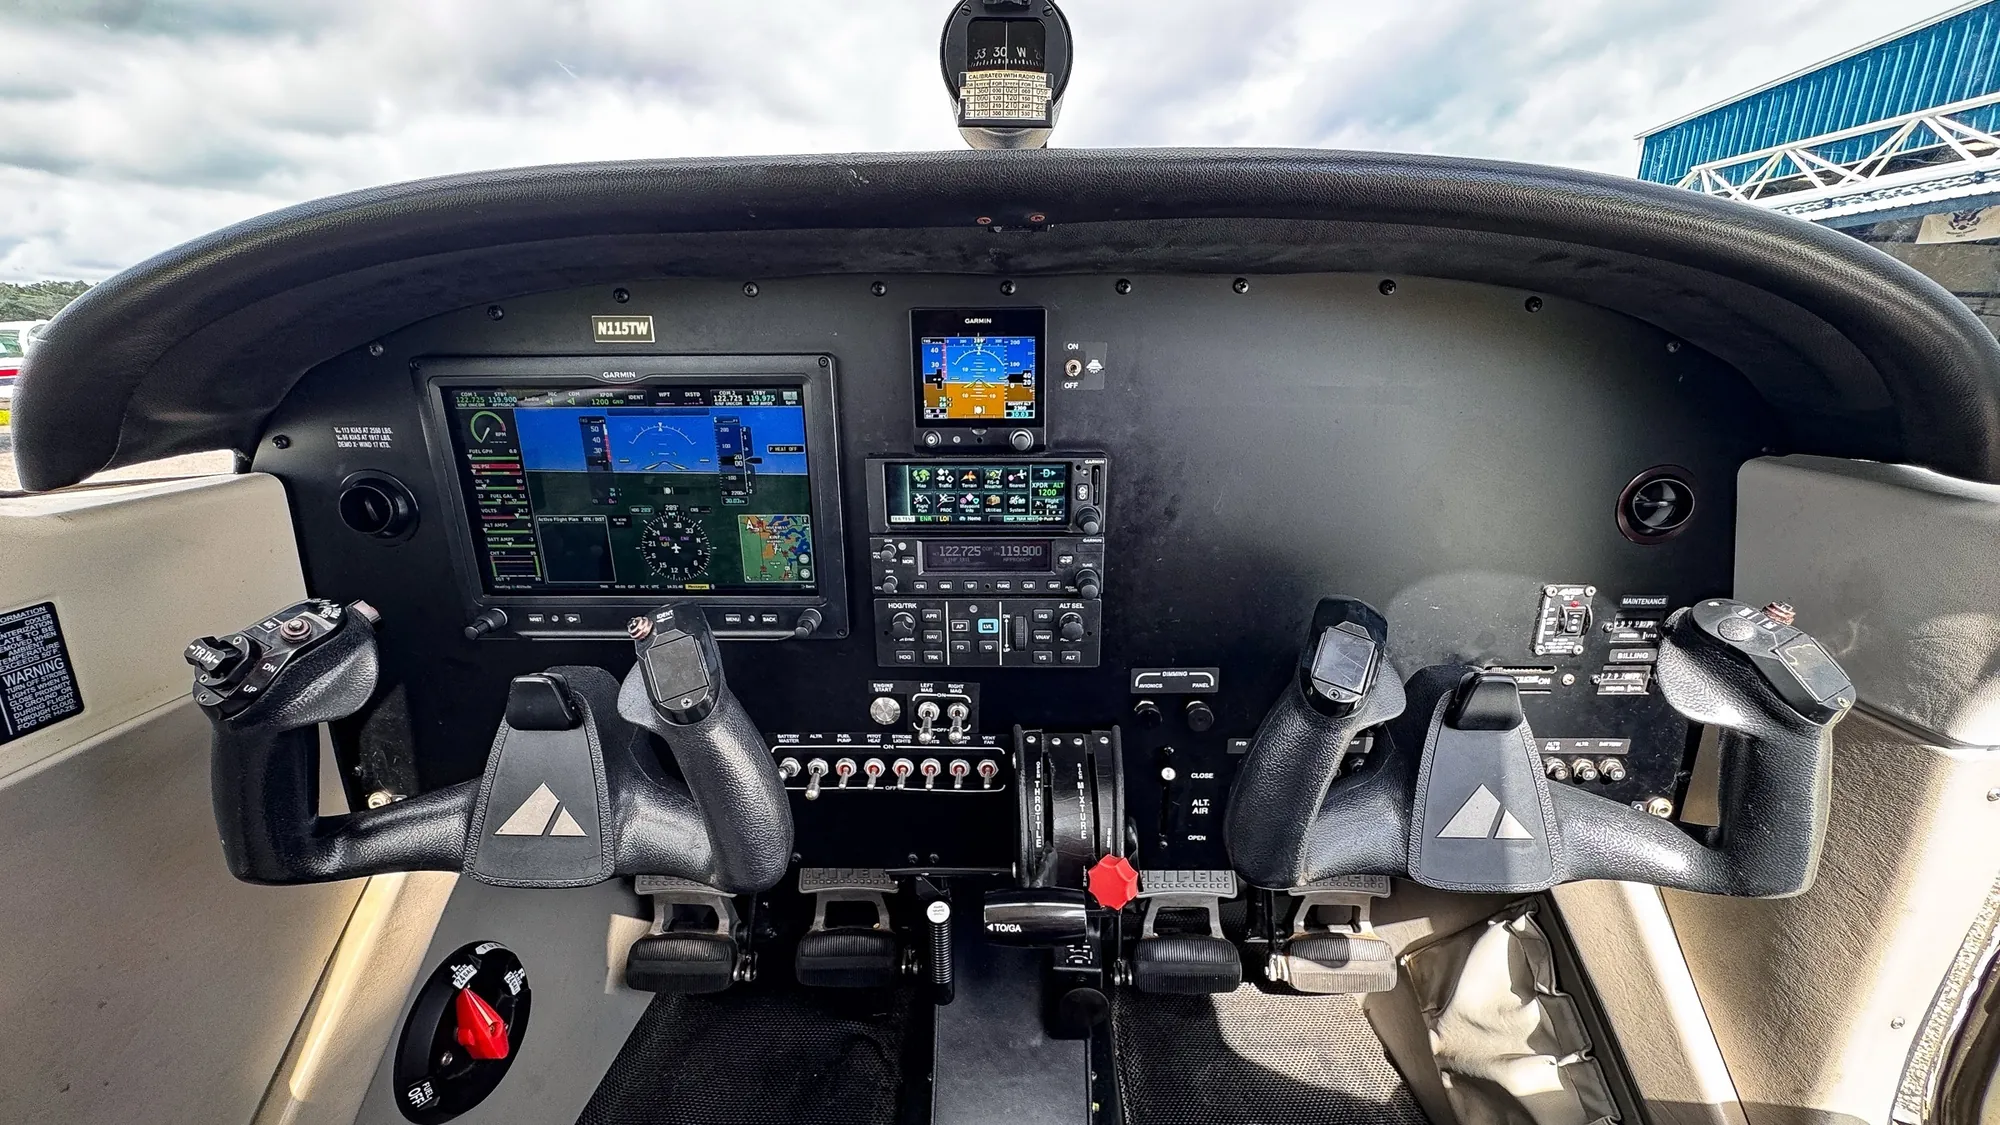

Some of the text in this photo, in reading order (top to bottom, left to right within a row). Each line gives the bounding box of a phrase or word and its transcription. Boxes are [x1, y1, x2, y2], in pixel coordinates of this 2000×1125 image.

[974, 48, 986, 60] 33
[993, 47, 1007, 58] 30
[1016, 46, 1027, 58] W
[598, 322, 648, 335] N115TW
[939, 546, 982, 557] 122.725
[1000, 546, 1042, 557] 119.900
[25, 614, 52, 626] COOLER
[656, 609, 674, 619] IDENT
[0, 620, 53, 640] NTERIZATION
[25, 630, 39, 638] TO
[41, 626, 55, 634] BE
[33, 631, 57, 642] WHEN
[8, 641, 44, 656] AMBIENT
[192, 646, 214, 664] TRIM
[0, 655, 40, 672] EXCEEDS
[262, 663, 276, 672] DN
[2, 658, 65, 688] WARNING
[6, 668, 68, 694] TURN OFF STROBE
[8, 674, 70, 701] LIGHTS WHEN IN
[10, 680, 71, 707] CLOSE PROXIMITY
[244, 684, 258, 693] UP
[11, 686, 73, 712] TO GROUND OR
[13, 692, 74, 719] DURING FLIGHT
[16, 708, 50, 725] THROUGH
[17, 720, 38, 732] FOG
[38, 712, 52, 722] OR
[1034, 780, 1042, 848] THROTTLE
[1077, 782, 1087, 839] MIXTURE
[994, 924, 1022, 932] TO/GA
[452, 964, 468, 978] TANK
[518, 968, 526, 979] R
[408, 1088, 424, 1104] OFF
[422, 1082, 433, 1098] FUEL
